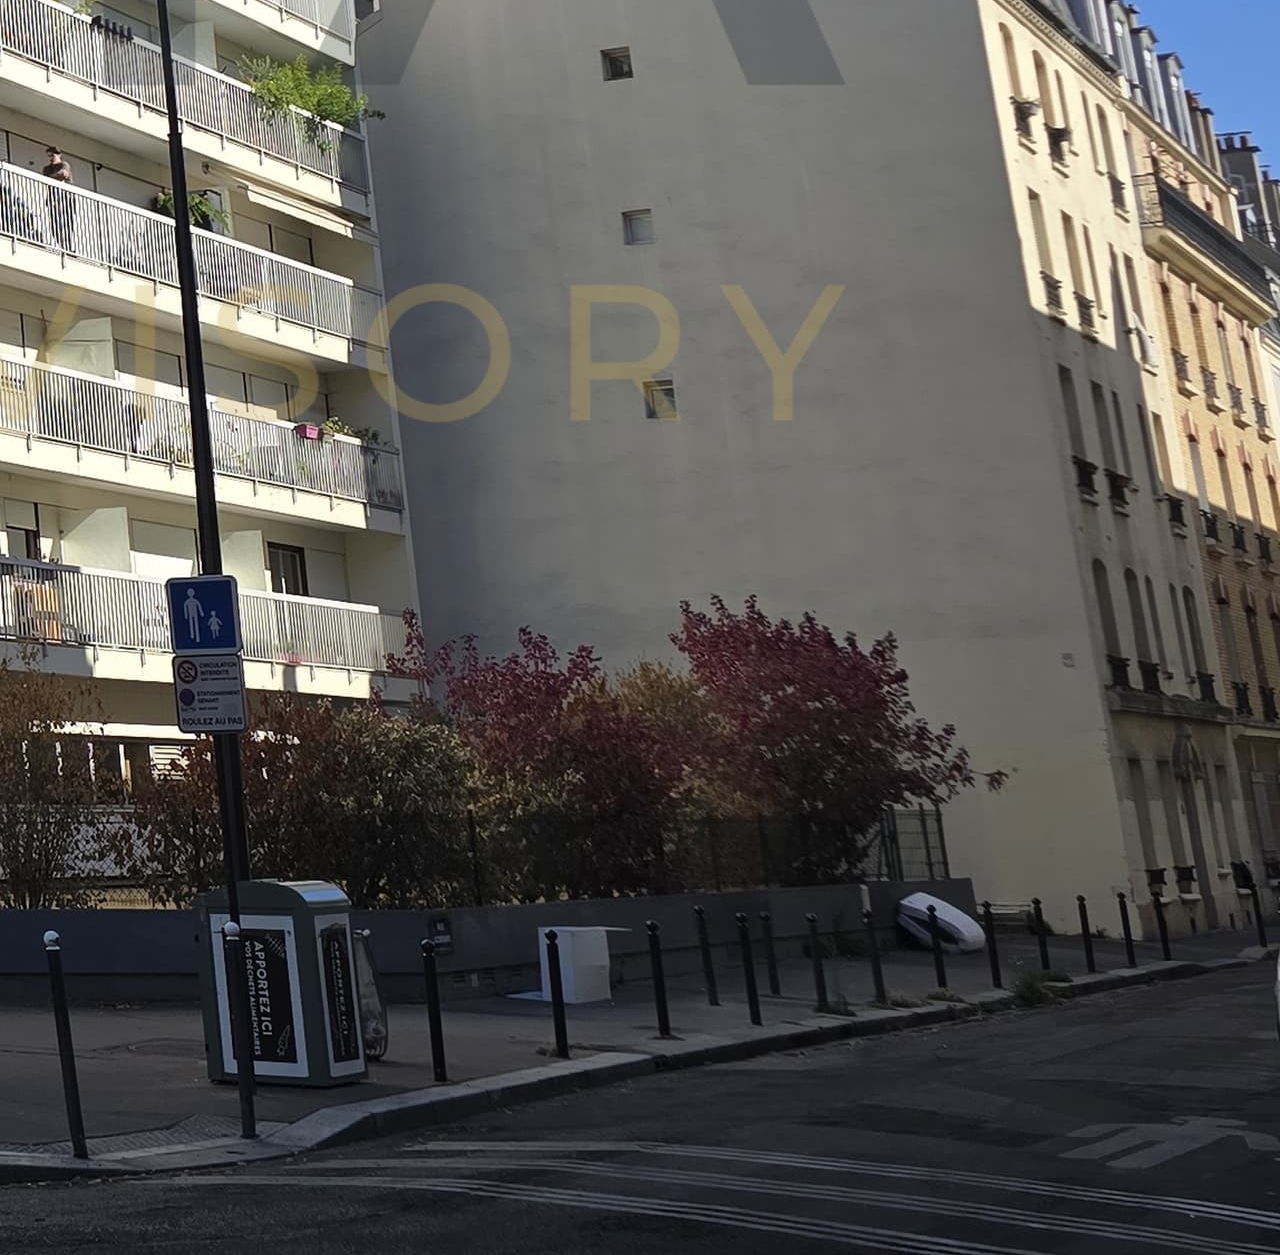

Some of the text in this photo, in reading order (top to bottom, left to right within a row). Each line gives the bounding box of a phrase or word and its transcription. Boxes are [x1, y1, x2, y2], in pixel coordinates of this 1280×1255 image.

[183, 718, 213, 726] ROULEZ
[228, 717, 243, 725] PAS
[244, 941, 252, 956] VOS
[248, 996, 261, 1055] ALIMENTAIRES
[254, 941, 273, 1036] APPORTEZ ICI
